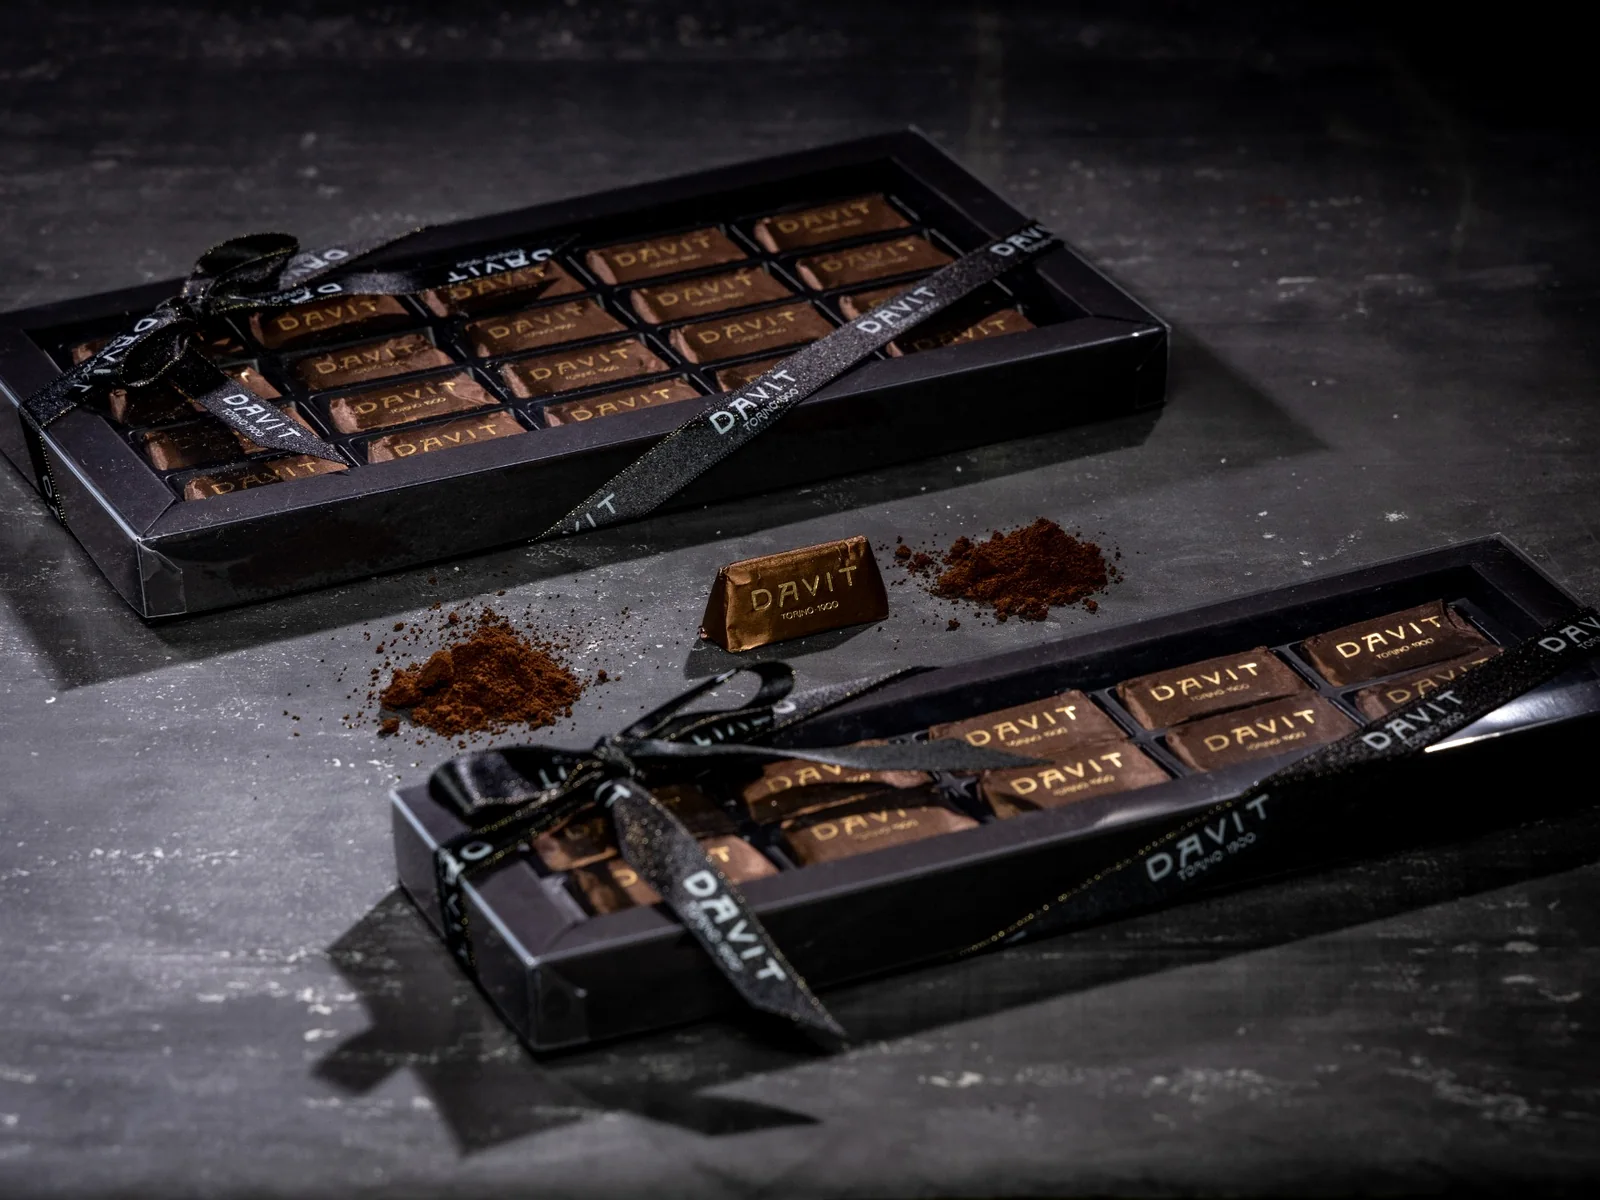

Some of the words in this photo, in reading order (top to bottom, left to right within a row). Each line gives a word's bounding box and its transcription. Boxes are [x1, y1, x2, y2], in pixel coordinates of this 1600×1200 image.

[777, 201, 871, 234] DAVIT
[613, 234, 713, 268] DAVIT
[822, 241, 916, 272] DAVIT
[990, 223, 1055, 257] DAV
[657, 273, 756, 307] DAVIT
[277, 299, 378, 332] DAVIT
[488, 304, 586, 340] DAVIT
[696, 310, 797, 345] DAVIT
[857, 286, 937, 334] DAVIT
[314, 343, 415, 374] DAVIT
[530, 347, 631, 382] DAVIT
[355, 380, 456, 415] DAVIT
[570, 388, 672, 422] DAVIT
[709, 369, 796, 435] DAVIT
[222, 393, 302, 441] DAVIT
[394, 423, 497, 458] DAVIT
[211, 461, 317, 496] DAVIT
[751, 565, 858, 612] DAVIT
[1336, 615, 1441, 659] DAVIT
[1150, 662, 1259, 703] DAVIT
[966, 704, 1077, 747] DAVIT
[1203, 709, 1315, 752] DAVIT
[1362, 690, 1463, 752] DAVIT
[765, 762, 842, 796] DAV
[1010, 751, 1123, 796] DAVIT
[1146, 793, 1271, 883] DAVIT
[683, 869, 787, 982] DAVIT
